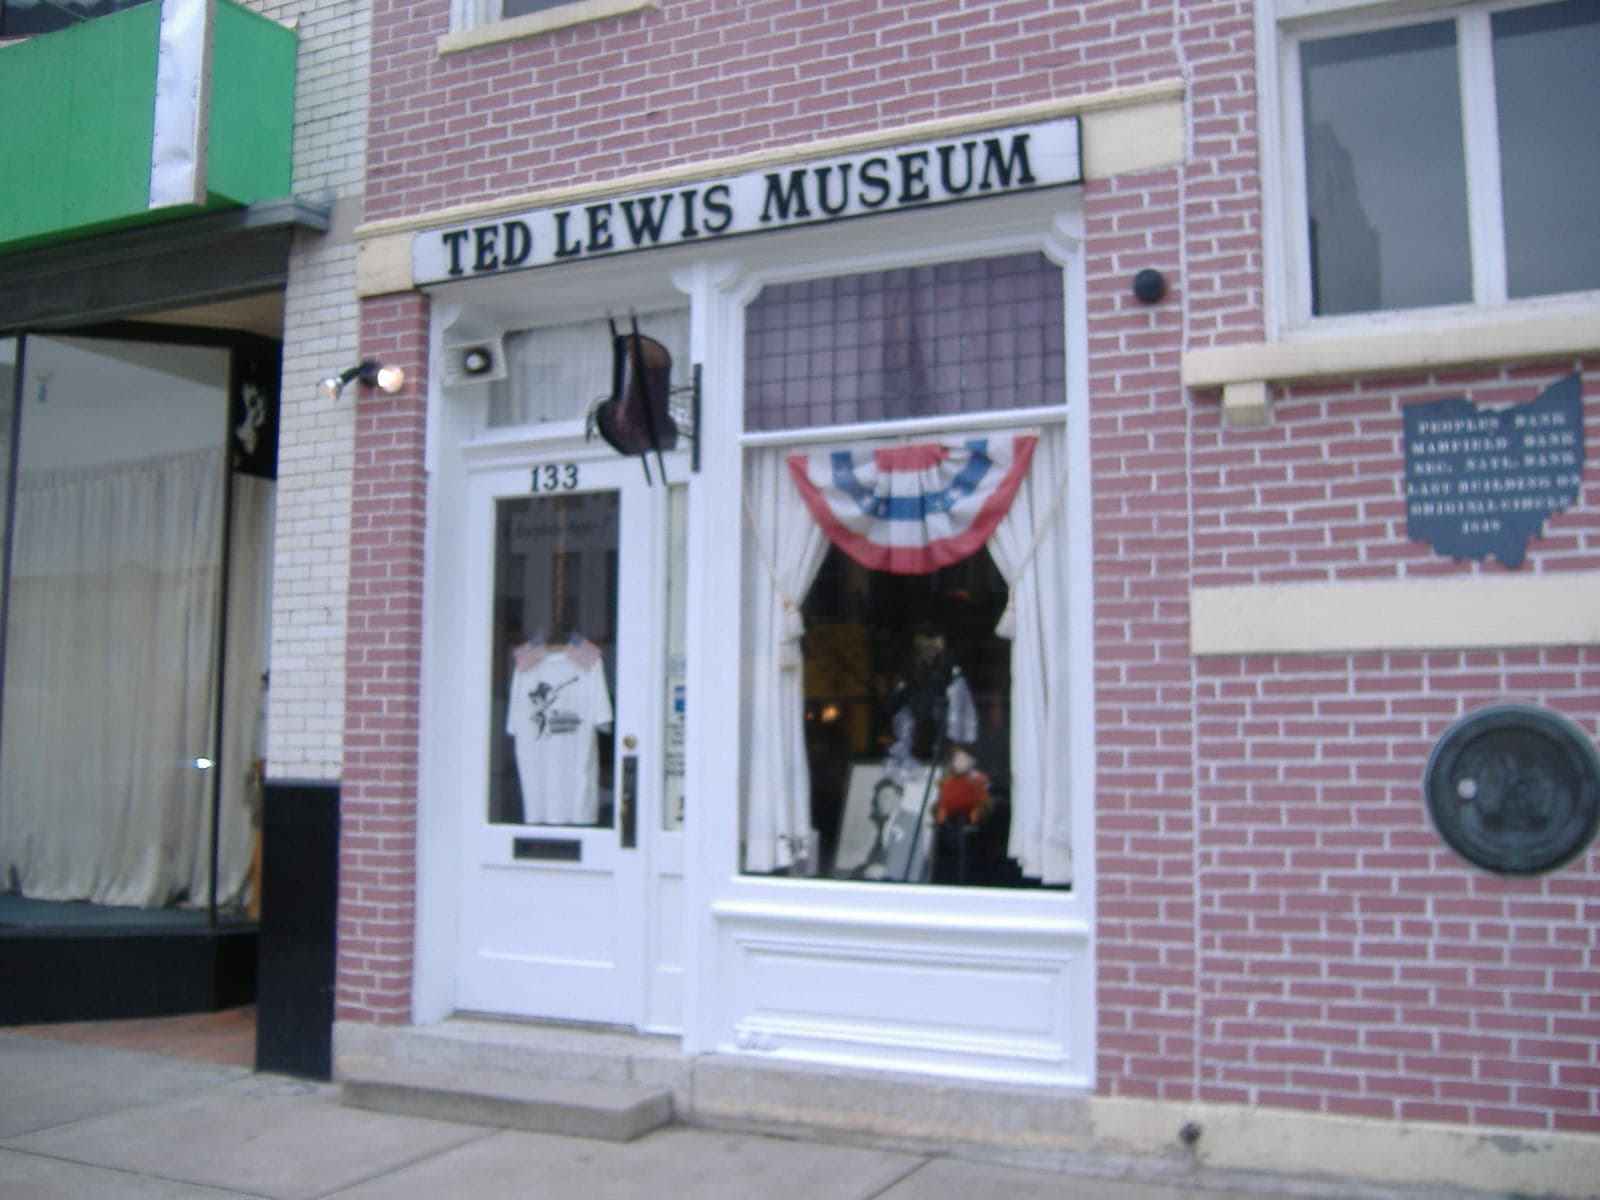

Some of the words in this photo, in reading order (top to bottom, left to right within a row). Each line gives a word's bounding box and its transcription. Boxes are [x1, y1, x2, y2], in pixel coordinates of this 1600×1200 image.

[442, 219, 533, 276] TED
[553, 183, 734, 259] LEWIS
[759, 132, 1037, 222] MUSEUM
[1515, 412, 1565, 428] BANK
[1523, 432, 1576, 448] BANK
[1523, 453, 1576, 467] BANK
[530, 463, 579, 492] 133
